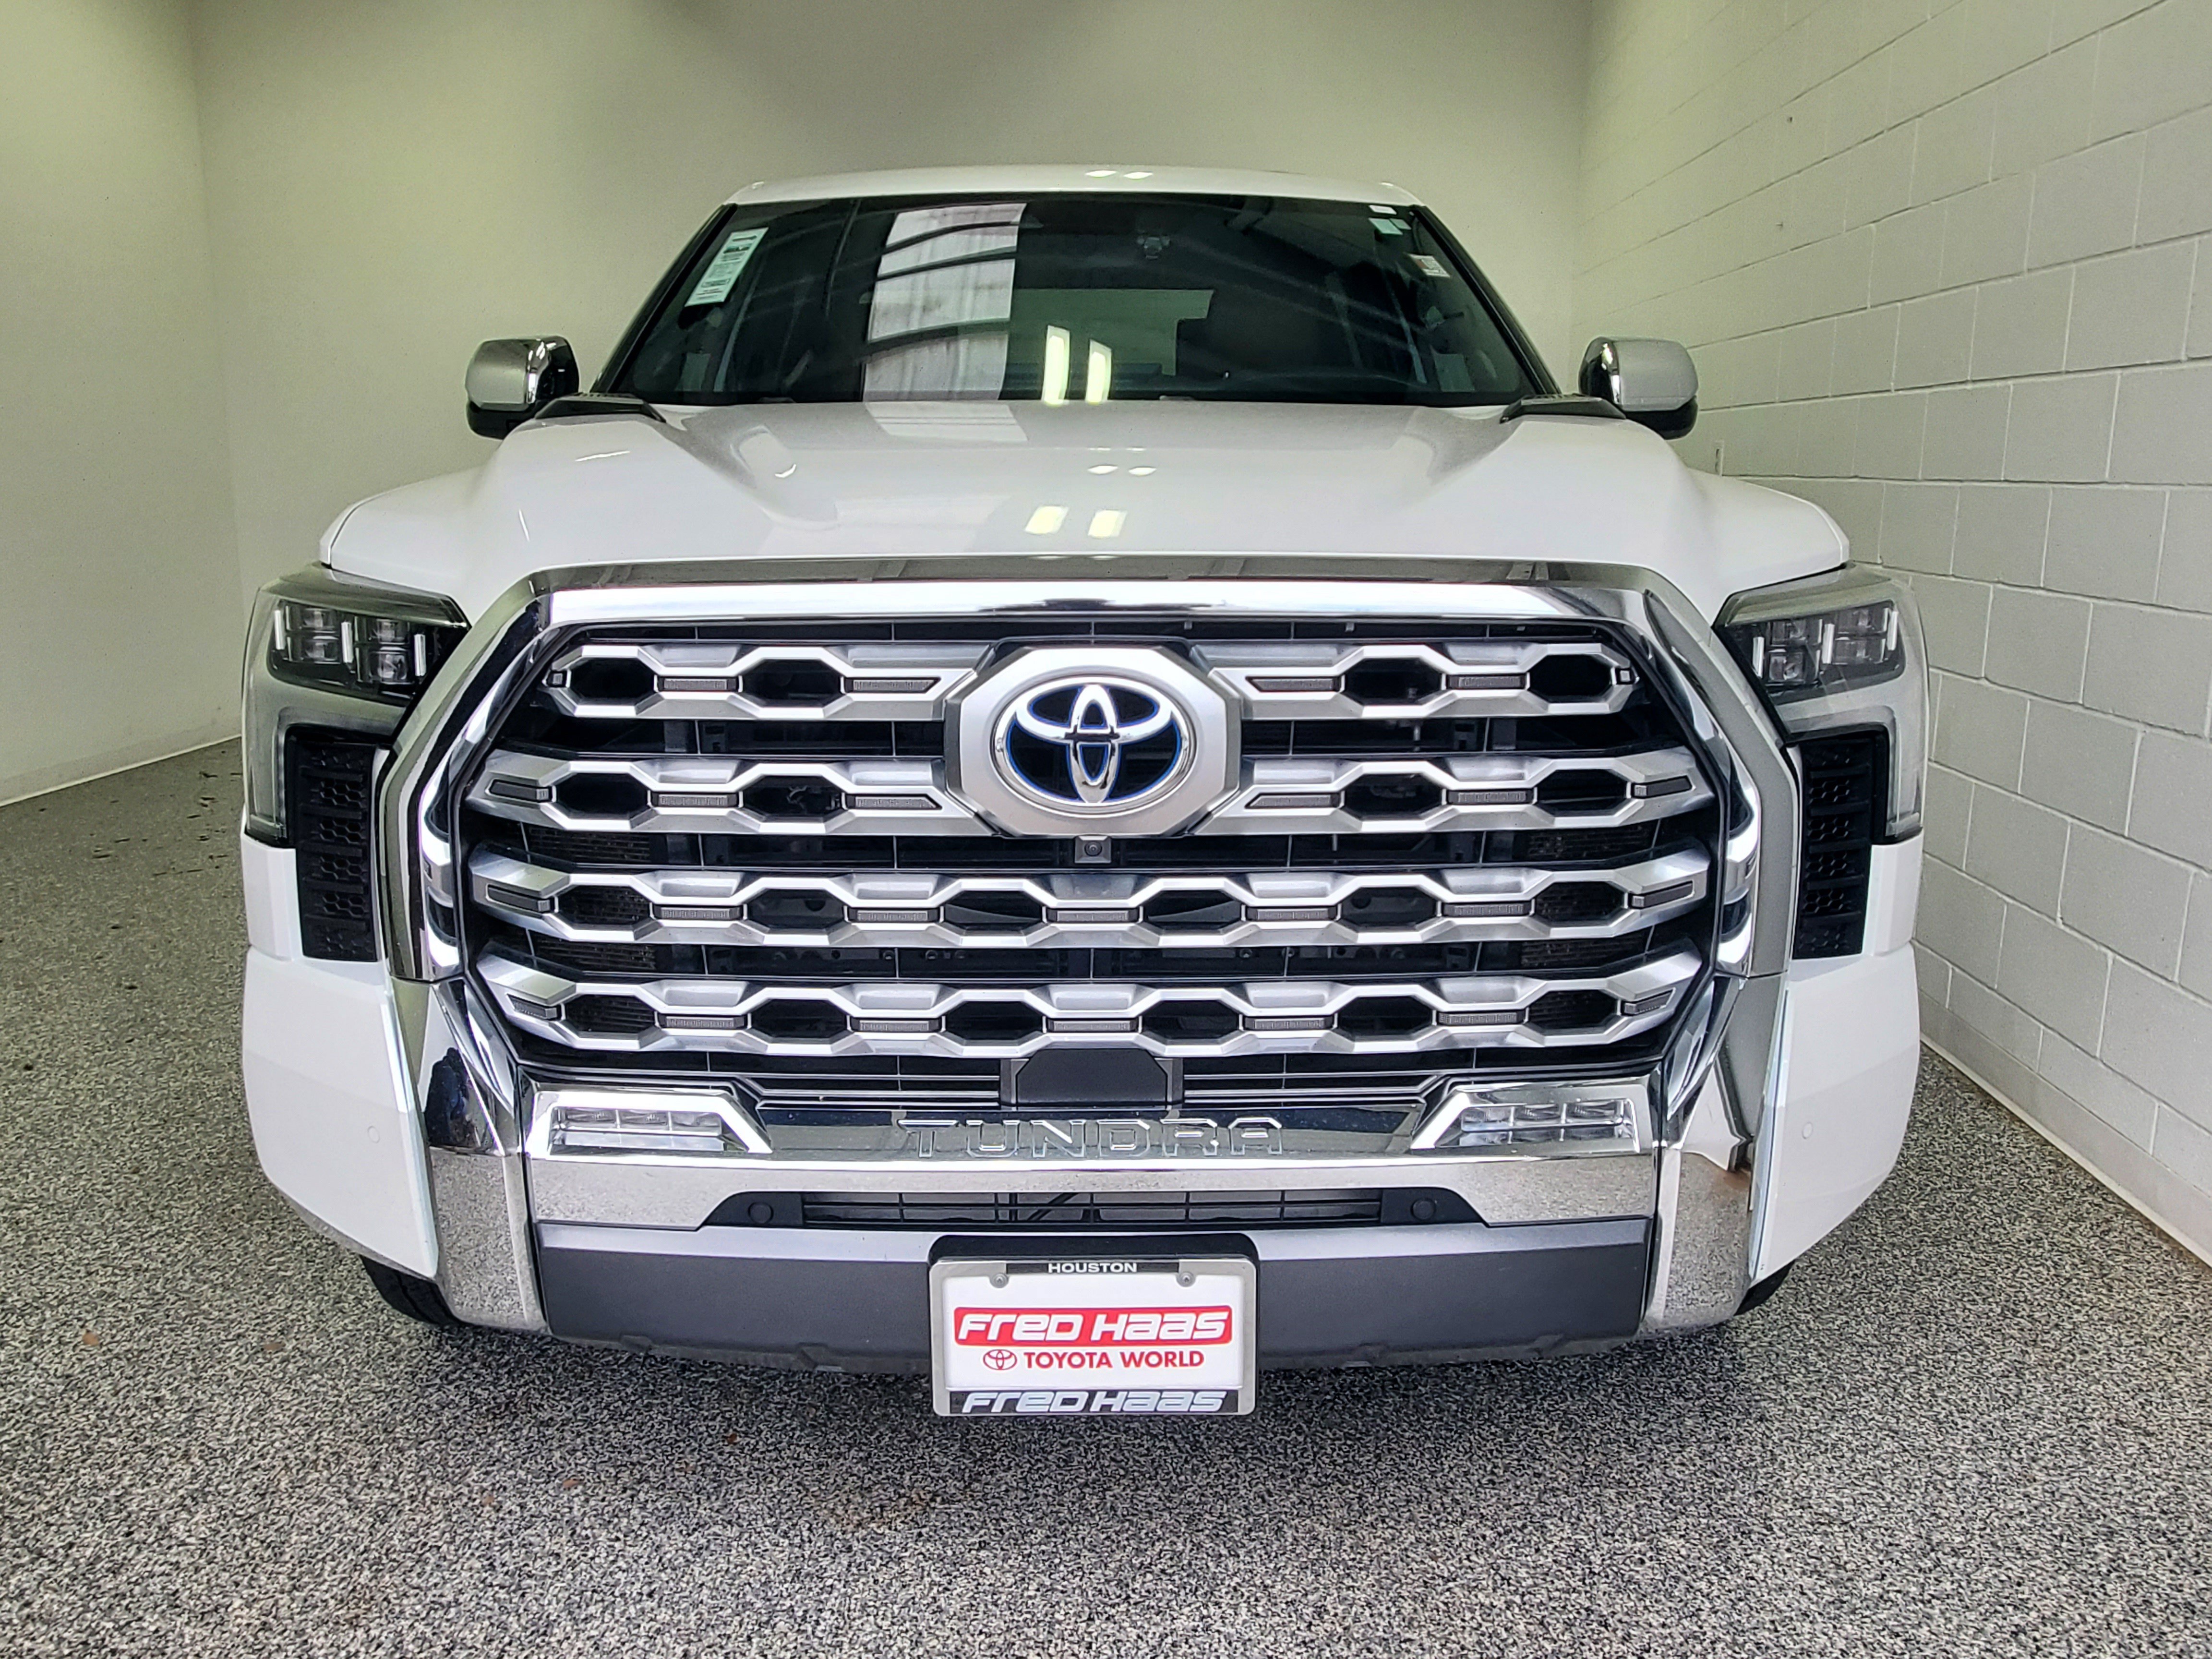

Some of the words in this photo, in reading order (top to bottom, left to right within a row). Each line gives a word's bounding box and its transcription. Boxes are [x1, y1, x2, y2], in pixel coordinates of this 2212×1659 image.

[897, 1117, 1283, 1159] TUNDRA
[1047, 1262, 1138, 1273] HOUSTON
[1024, 1351, 1112, 1368] TOYOTA
[1121, 1350, 1204, 1368] WORLD
